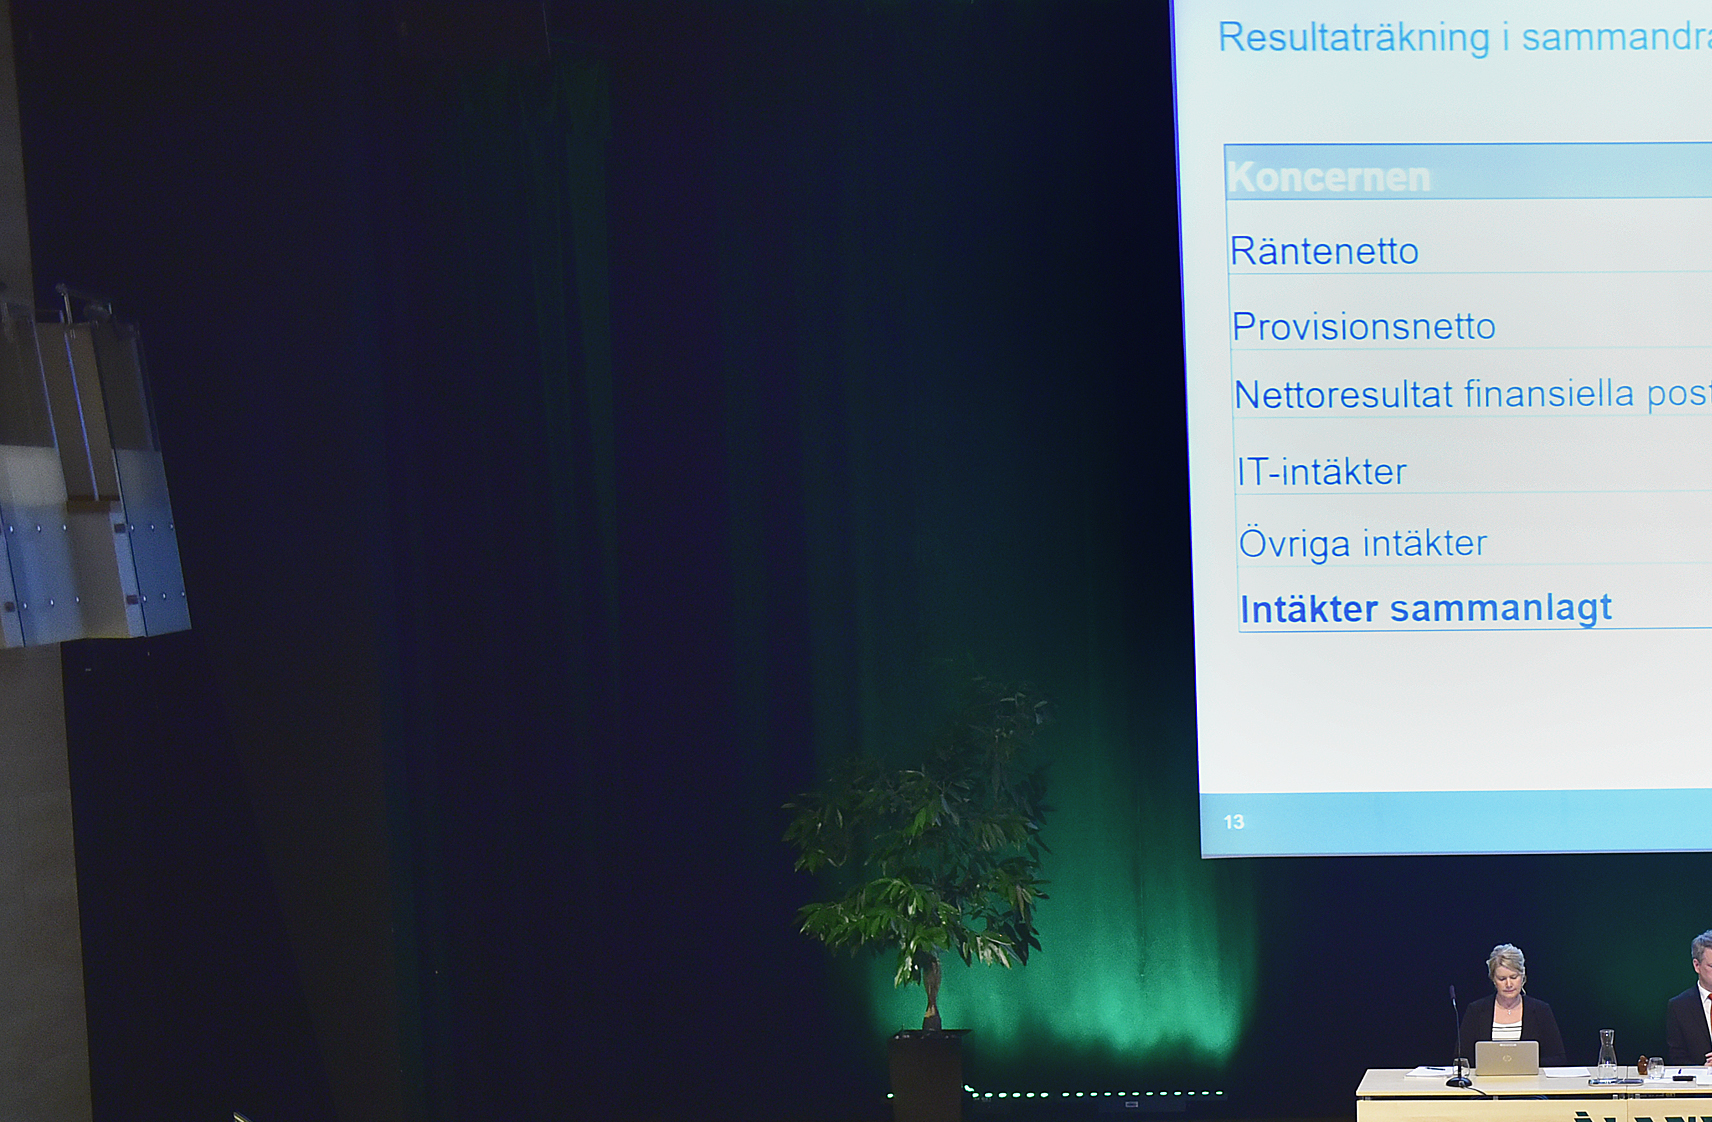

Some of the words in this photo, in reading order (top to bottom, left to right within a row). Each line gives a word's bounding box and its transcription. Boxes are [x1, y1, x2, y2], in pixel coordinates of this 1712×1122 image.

[1219, 20, 1490, 60] Resultaträkning
[1503, 20, 1509, 51] i
[1227, 161, 1431, 192] Koncernen
[1231, 235, 1419, 266] Räntenetto
[1233, 310, 1496, 341] Provisionsnetto
[1235, 378, 1454, 409] Nettoresultat
[1463, 377, 1634, 408] finansiella
[1238, 456, 1408, 486] IT-intäkter
[1239, 523, 1350, 566] Övriga
[1364, 527, 1489, 557] intäkter
[1241, 594, 1380, 624] Intäkter
[1390, 592, 1613, 629] sammanlagt
[1223, 813, 1245, 830] 13
